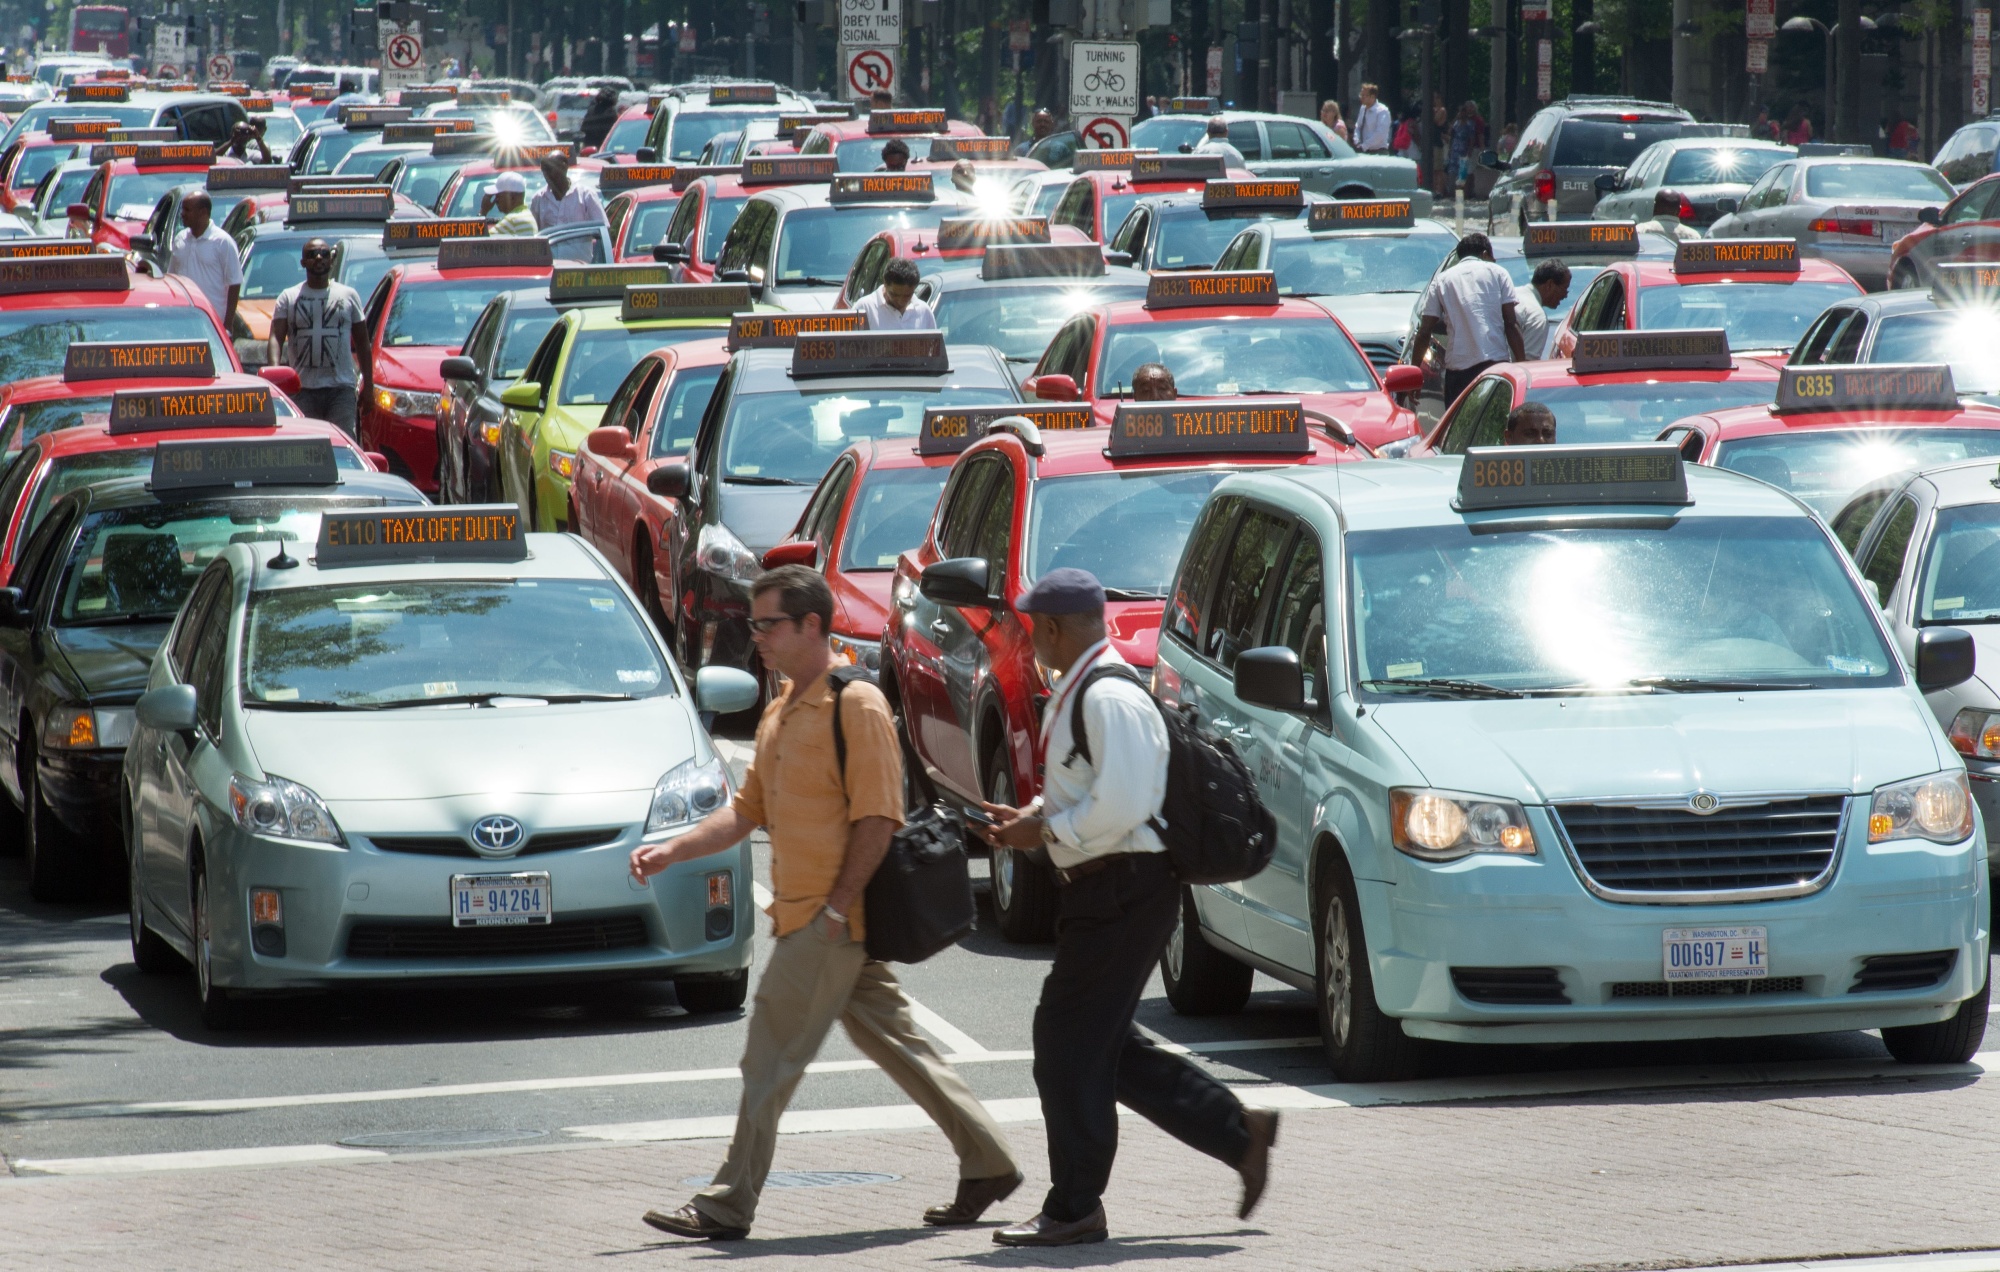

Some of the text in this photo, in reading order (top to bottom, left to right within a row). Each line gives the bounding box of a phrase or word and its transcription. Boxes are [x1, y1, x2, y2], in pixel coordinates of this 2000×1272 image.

[843, 15, 899, 27] OBEY THIS
[843, 29, 881, 41] SIGNAL
[1086, 50, 1125, 62] TURNING
[1073, 95, 1135, 107] USE X-WALKS
[161, 147, 178, 157] TAXI
[178, 146, 192, 157] OFF
[193, 146, 212, 157] DUTY
[752, 163, 773, 176] E015
[864, 178, 886, 191] TAXI
[887, 177, 904, 191] OFF
[905, 178, 930, 191] DUTY
[1235, 184, 1256, 197] TAXI
[1257, 184, 1274, 197] OFF
[1275, 184, 1299, 196] DUTY
[1563, 180, 1589, 191] ELITE
[296, 202, 319, 214] B168
[1342, 204, 1409, 218] TAXI OFF DUTY
[1855, 208, 1880, 216] SILVER
[390, 222, 484, 239] B937 TAXI OFF DUTY
[1605, 227, 1634, 241] DUTY
[1682, 244, 1795, 262] E358 TAXI OFF DUTY
[556, 271, 585, 288] B677
[1154, 276, 1272, 297] D832 TAXI OFF DUTY
[1976, 269, 2000, 287] TAX
[631, 292, 658, 309] G029
[737, 320, 764, 338] J097
[773, 318, 803, 337] TAXI
[71, 345, 207, 368] C472 TAXI OFF DUTY
[800, 340, 836, 360] B653
[1583, 339, 1619, 358] E209
[1796, 371, 1944, 397] C835 TAXI OFF DUTY
[118, 392, 267, 419] B691 TAXI OFF DUTY
[930, 415, 968, 438] C868
[1125, 410, 1299, 438] B868 TAXI OFF DUTY
[161, 450, 203, 473] F986
[1473, 459, 1525, 488] B688
[328, 515, 516, 546] E110 TAXI OFF DUTY
[459, 888, 541, 914] H 94264
[476, 916, 529, 926] KOONS.COM
[1729, 929, 1738, 937] DC
[1670, 941, 1760, 967] 00697 H
[1668, 968, 1765, 979] TAXATION WITHOUT REPRESENTATION
